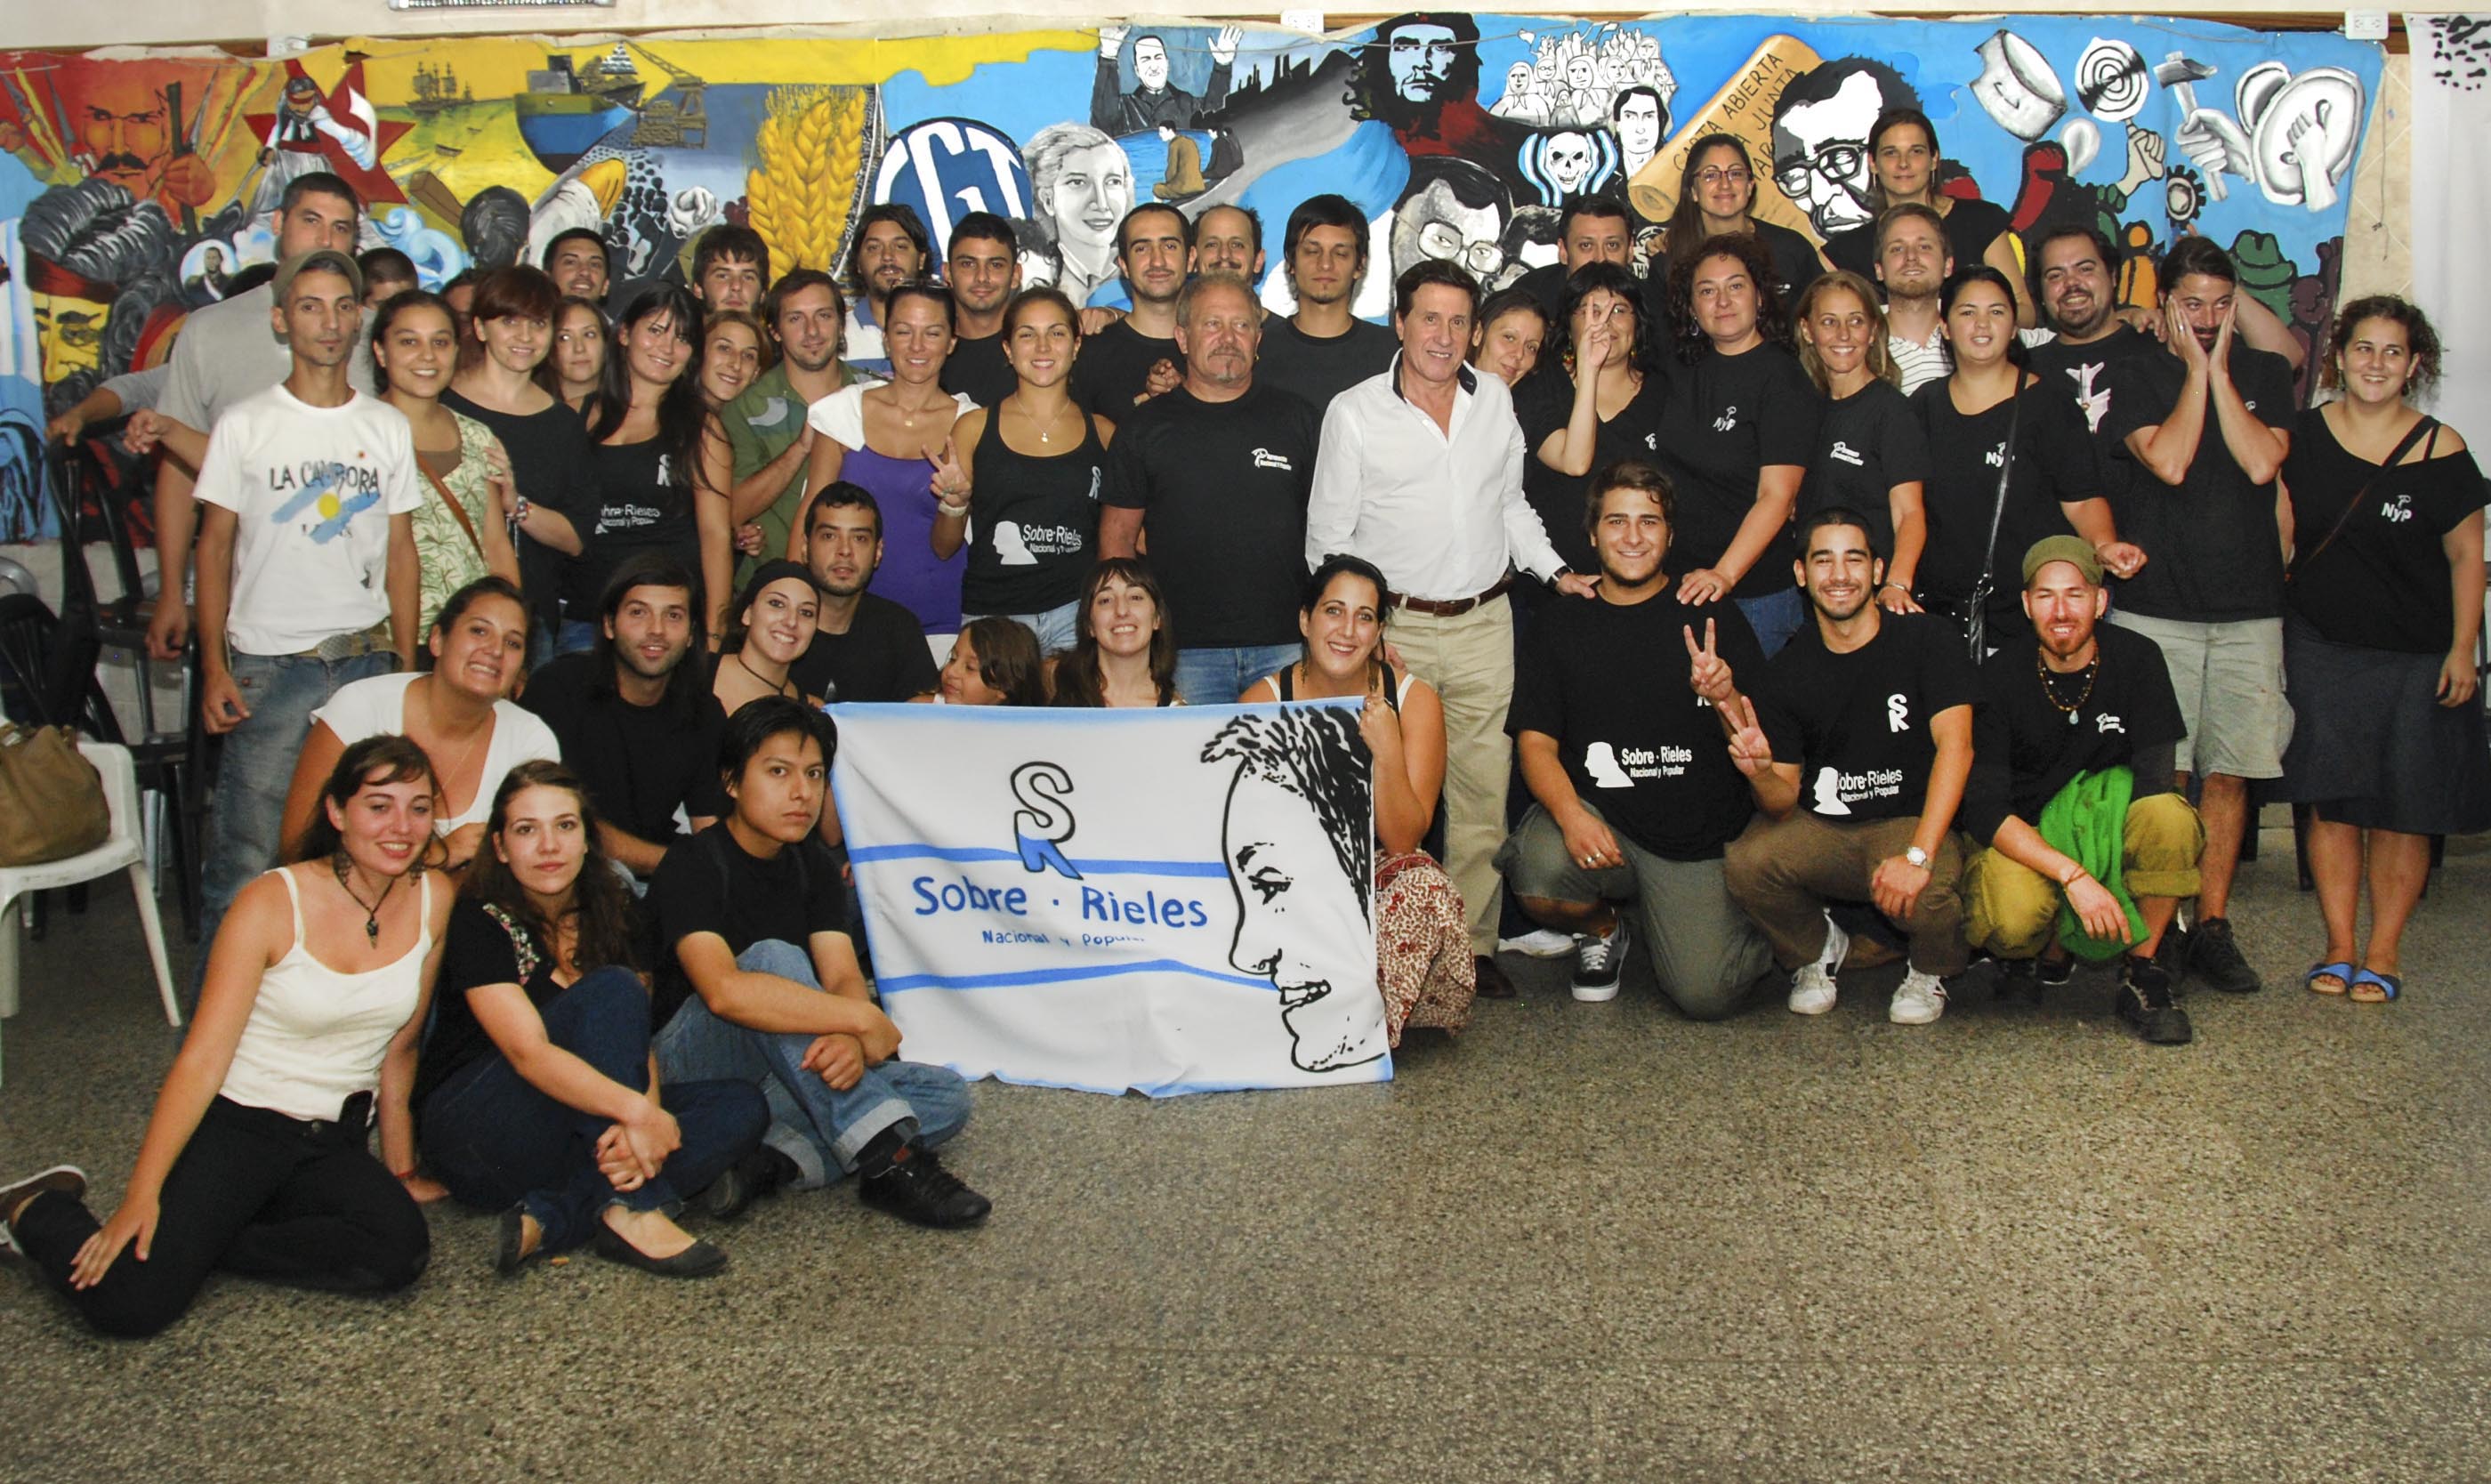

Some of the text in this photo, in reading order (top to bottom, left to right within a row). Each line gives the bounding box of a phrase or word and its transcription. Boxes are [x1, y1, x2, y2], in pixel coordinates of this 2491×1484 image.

[1721, 52, 1784, 120] ABIERTA
[270, 464, 296, 491] LA
[1022, 524, 1053, 542] Sobre
[1621, 746, 1692, 766] Sobre Rieles
[1836, 768, 1903, 791] obre Rieles
[912, 875, 1208, 929] Sobre Rieles
[981, 930, 1051, 945] Nacional
